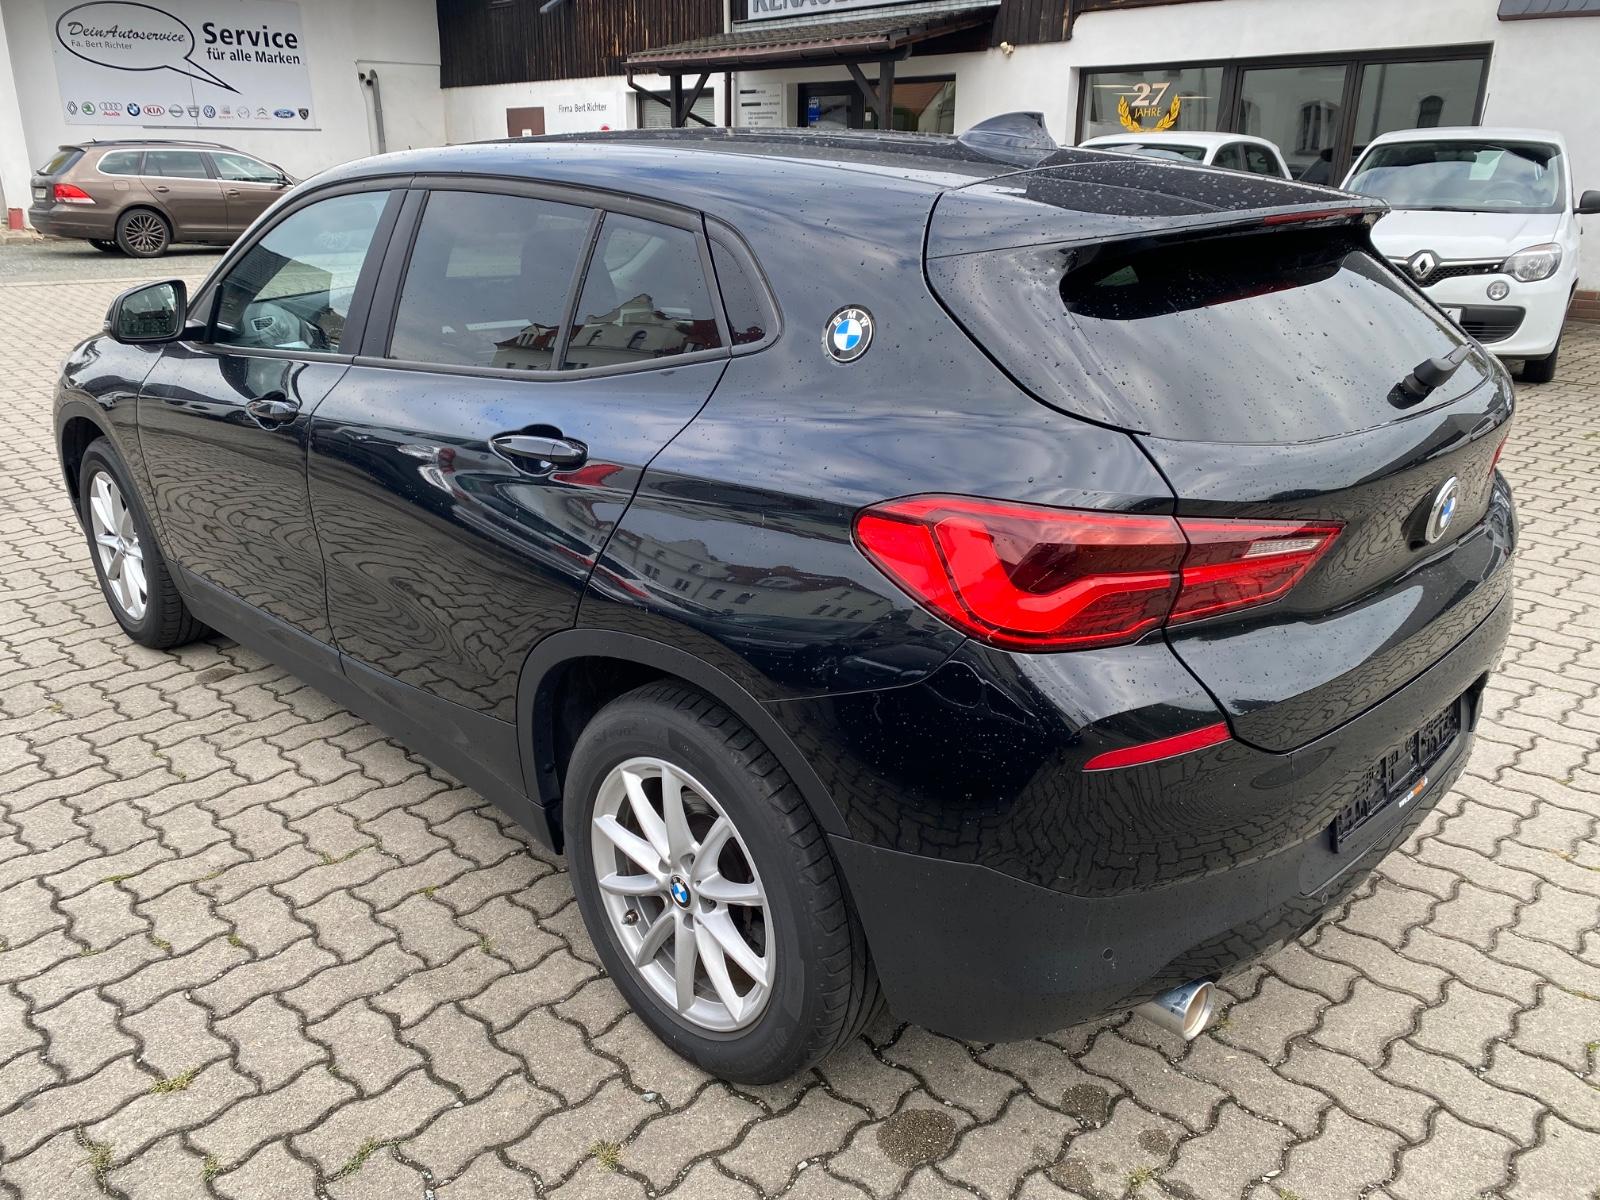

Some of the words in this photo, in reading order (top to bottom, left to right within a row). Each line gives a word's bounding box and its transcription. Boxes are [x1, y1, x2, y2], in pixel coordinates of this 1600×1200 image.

[202, 22, 298, 49] Service
[71, 40, 84, 48] Fa.
[85, 40, 102, 49] Bert
[104, 41, 132, 50] Richter
[206, 47, 225, 60] für
[229, 49, 252, 62] alle
[255, 51, 300, 64] Marken
[1131, 81, 1171, 107] 27
[558, 104, 573, 113] Firma
[574, 103, 586, 113] Bert
[586, 101, 607, 112] Richter
[1134, 107, 1161, 119] JAHRE
[832, 310, 869, 328] BMW
